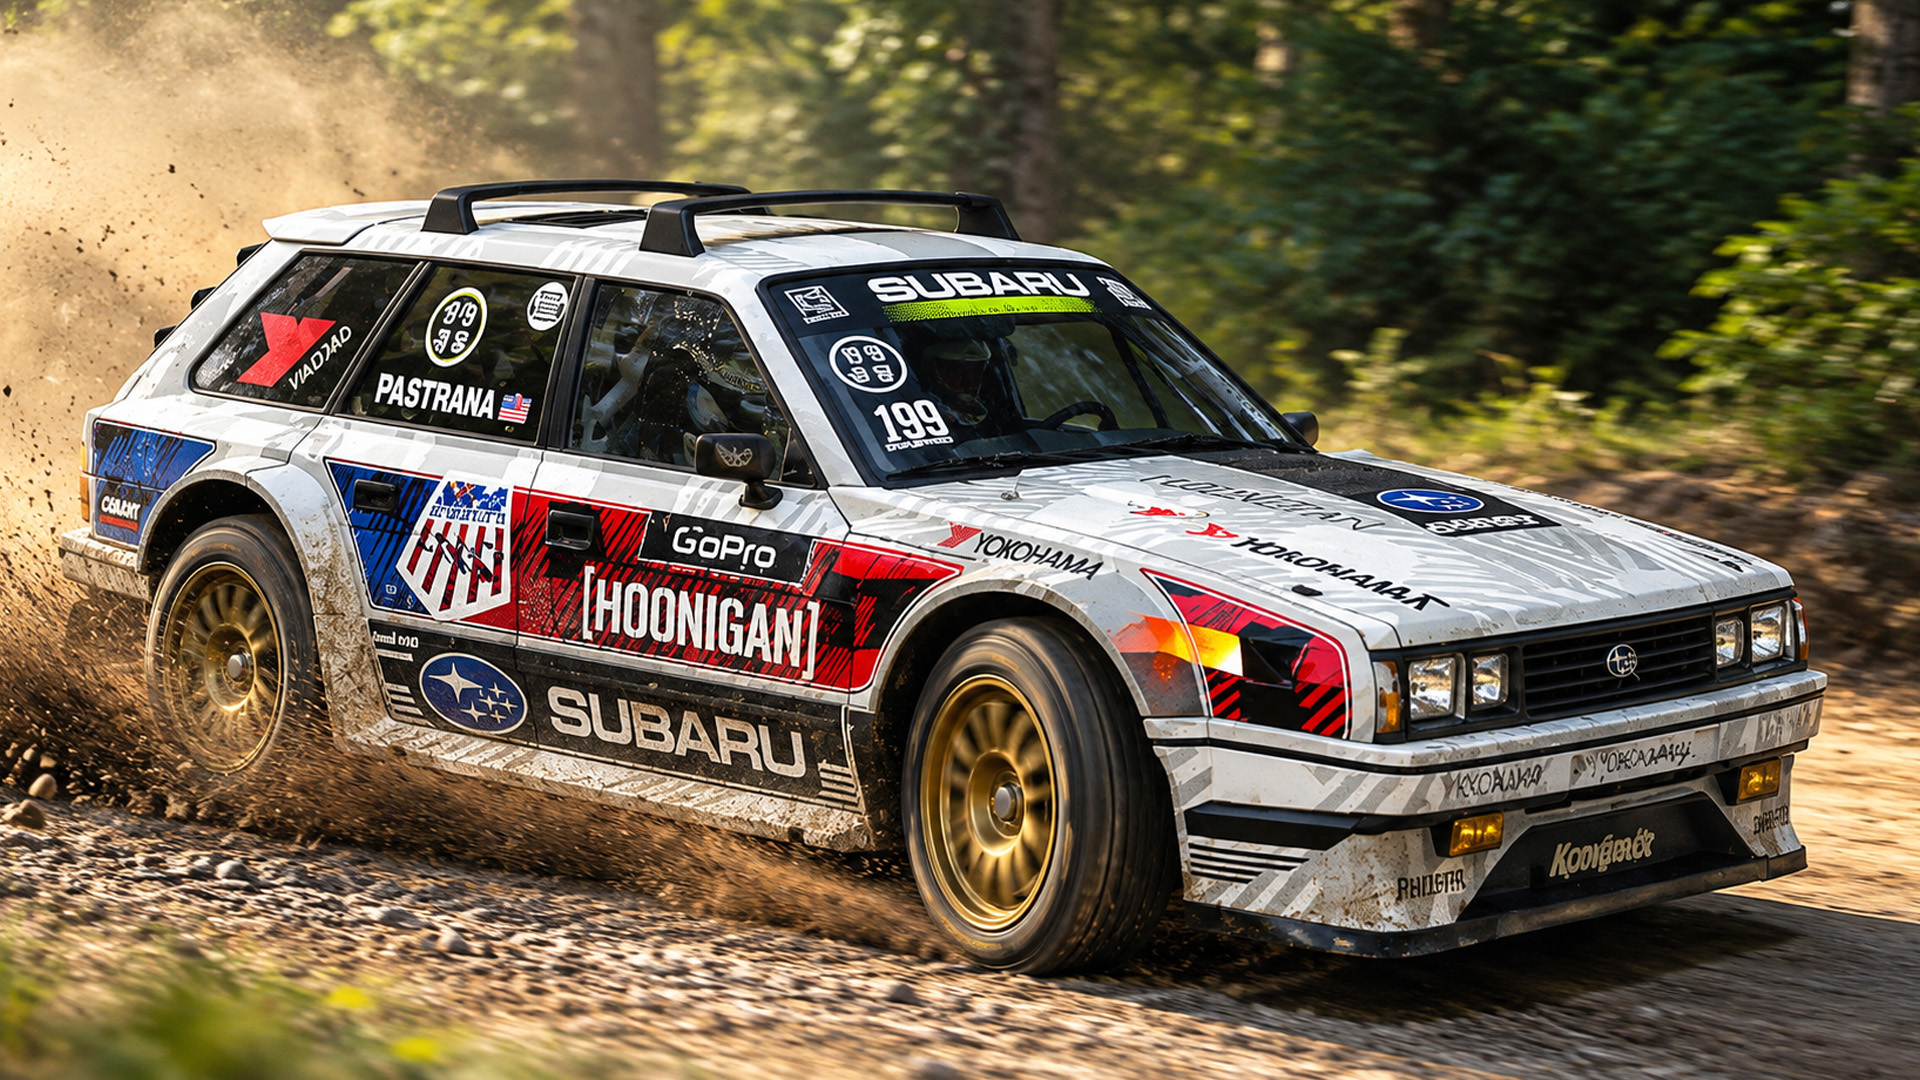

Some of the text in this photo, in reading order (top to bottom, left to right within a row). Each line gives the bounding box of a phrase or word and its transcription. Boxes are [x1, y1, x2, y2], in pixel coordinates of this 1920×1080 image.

[868, 271, 1090, 302] SUBARU
[374, 372, 495, 419] PASTRANA
[873, 399, 950, 442] 199
[672, 526, 776, 567] GoPro
[973, 532, 1104, 580] YOKOHAMA
[547, 686, 806, 778] SUBARU
